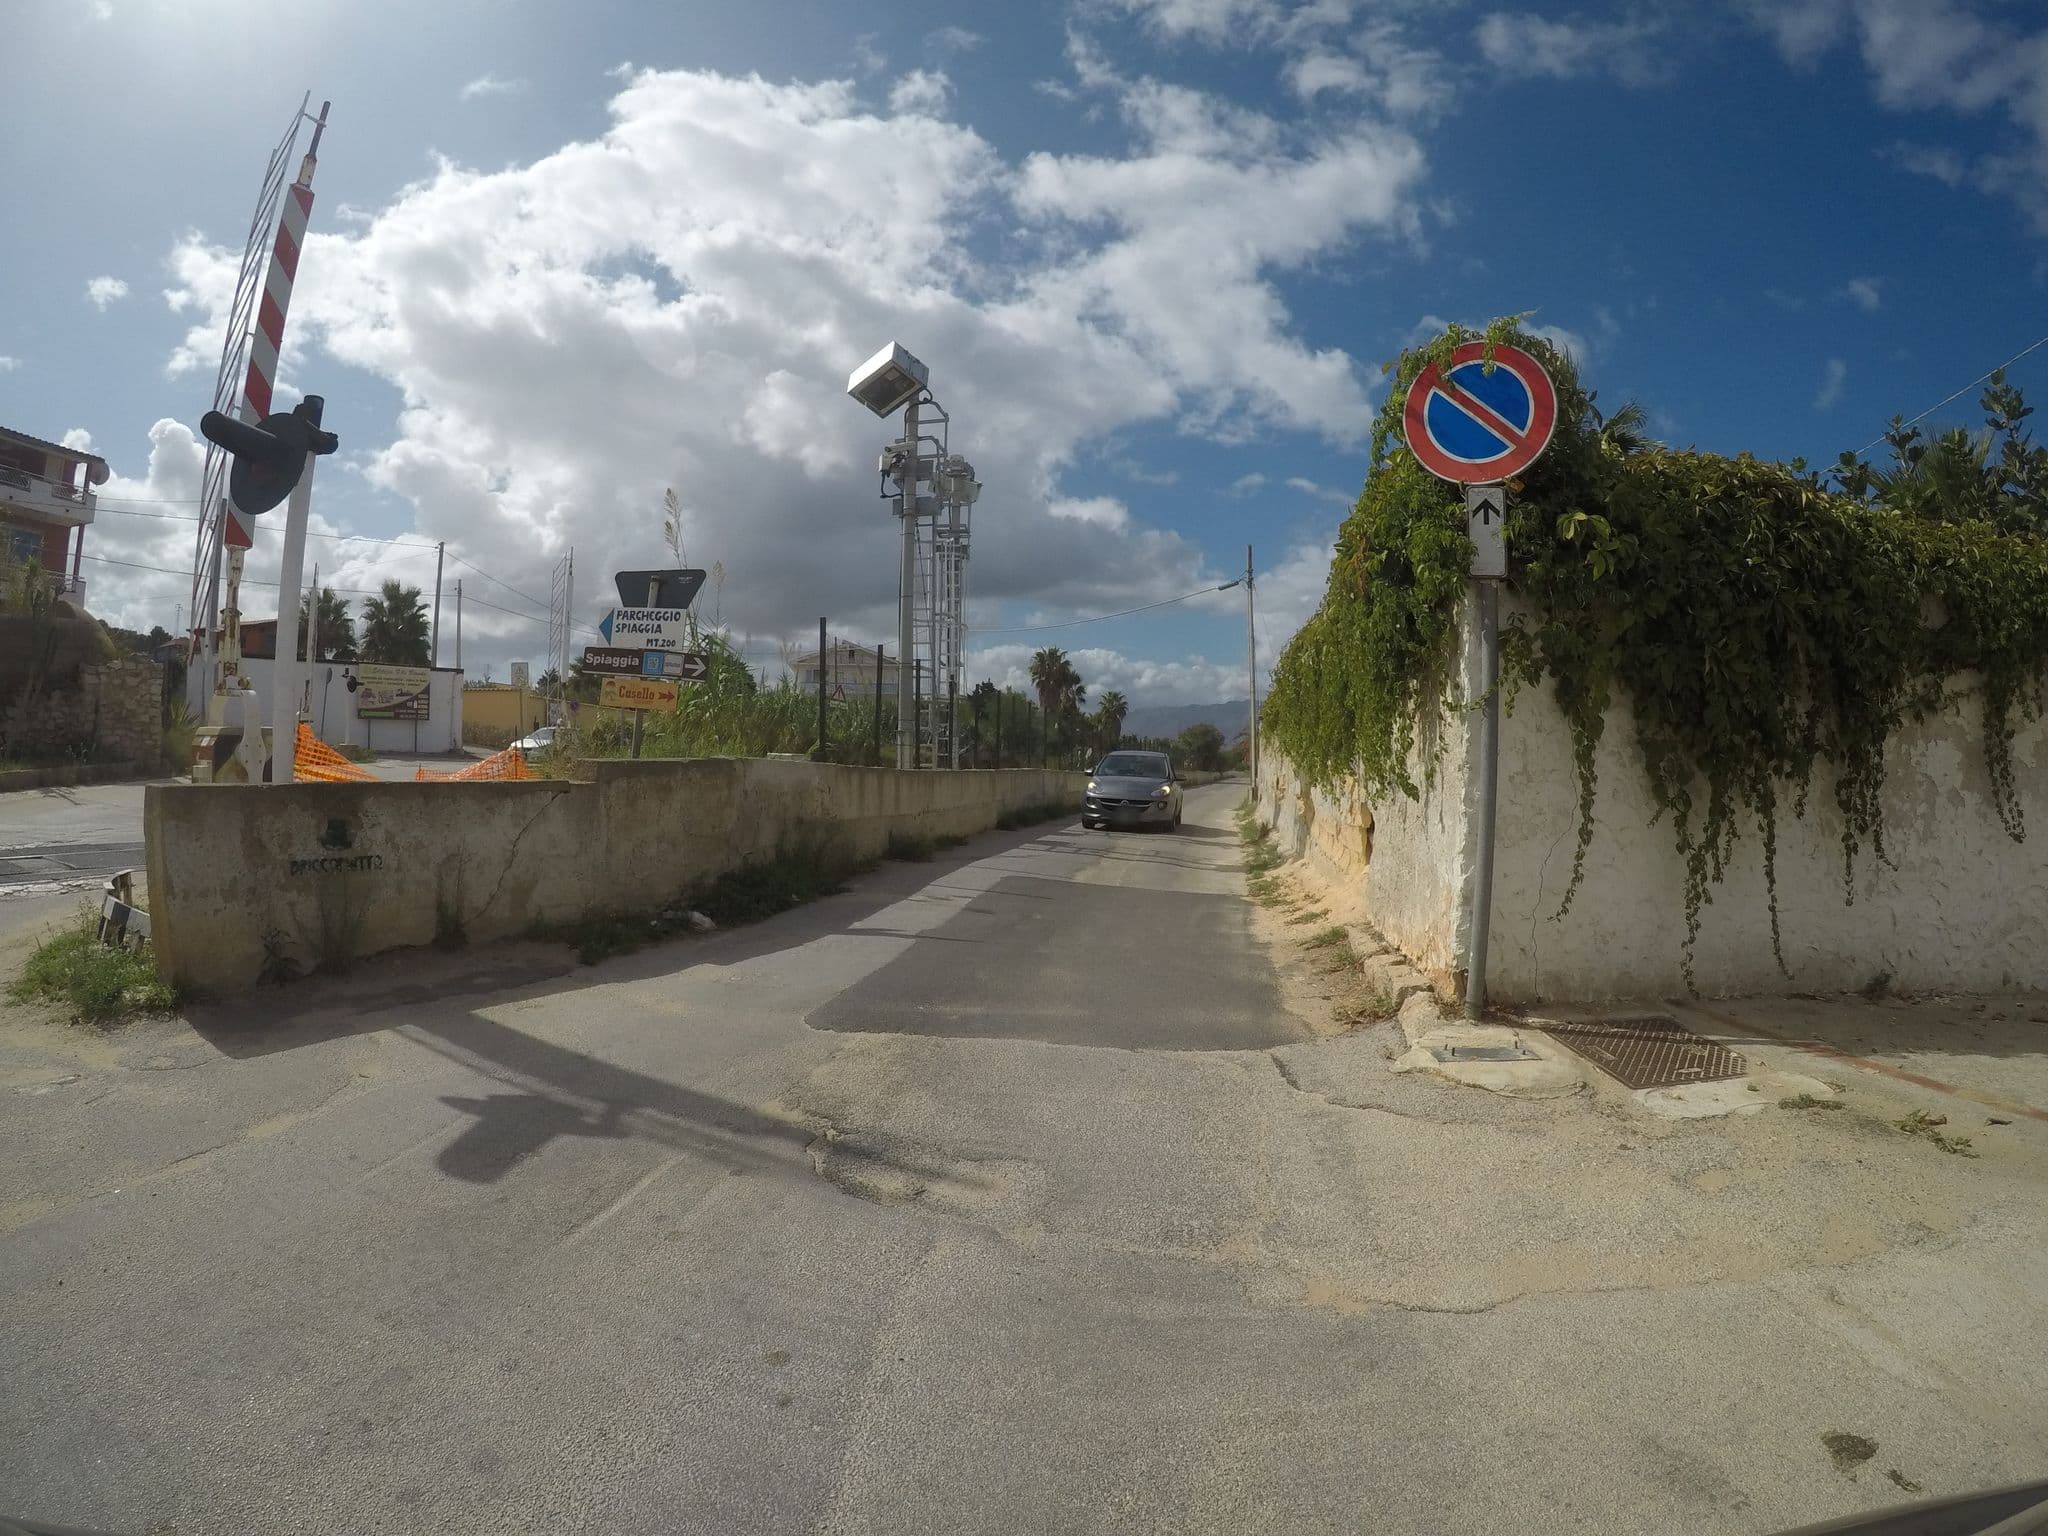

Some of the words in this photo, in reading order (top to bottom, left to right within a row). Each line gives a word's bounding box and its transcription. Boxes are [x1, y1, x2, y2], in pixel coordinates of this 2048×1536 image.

[616, 610, 681, 622] PARCHEGGIO
[615, 622, 662, 634] SPIAGGIA
[585, 653, 640, 668] Spiaggia
